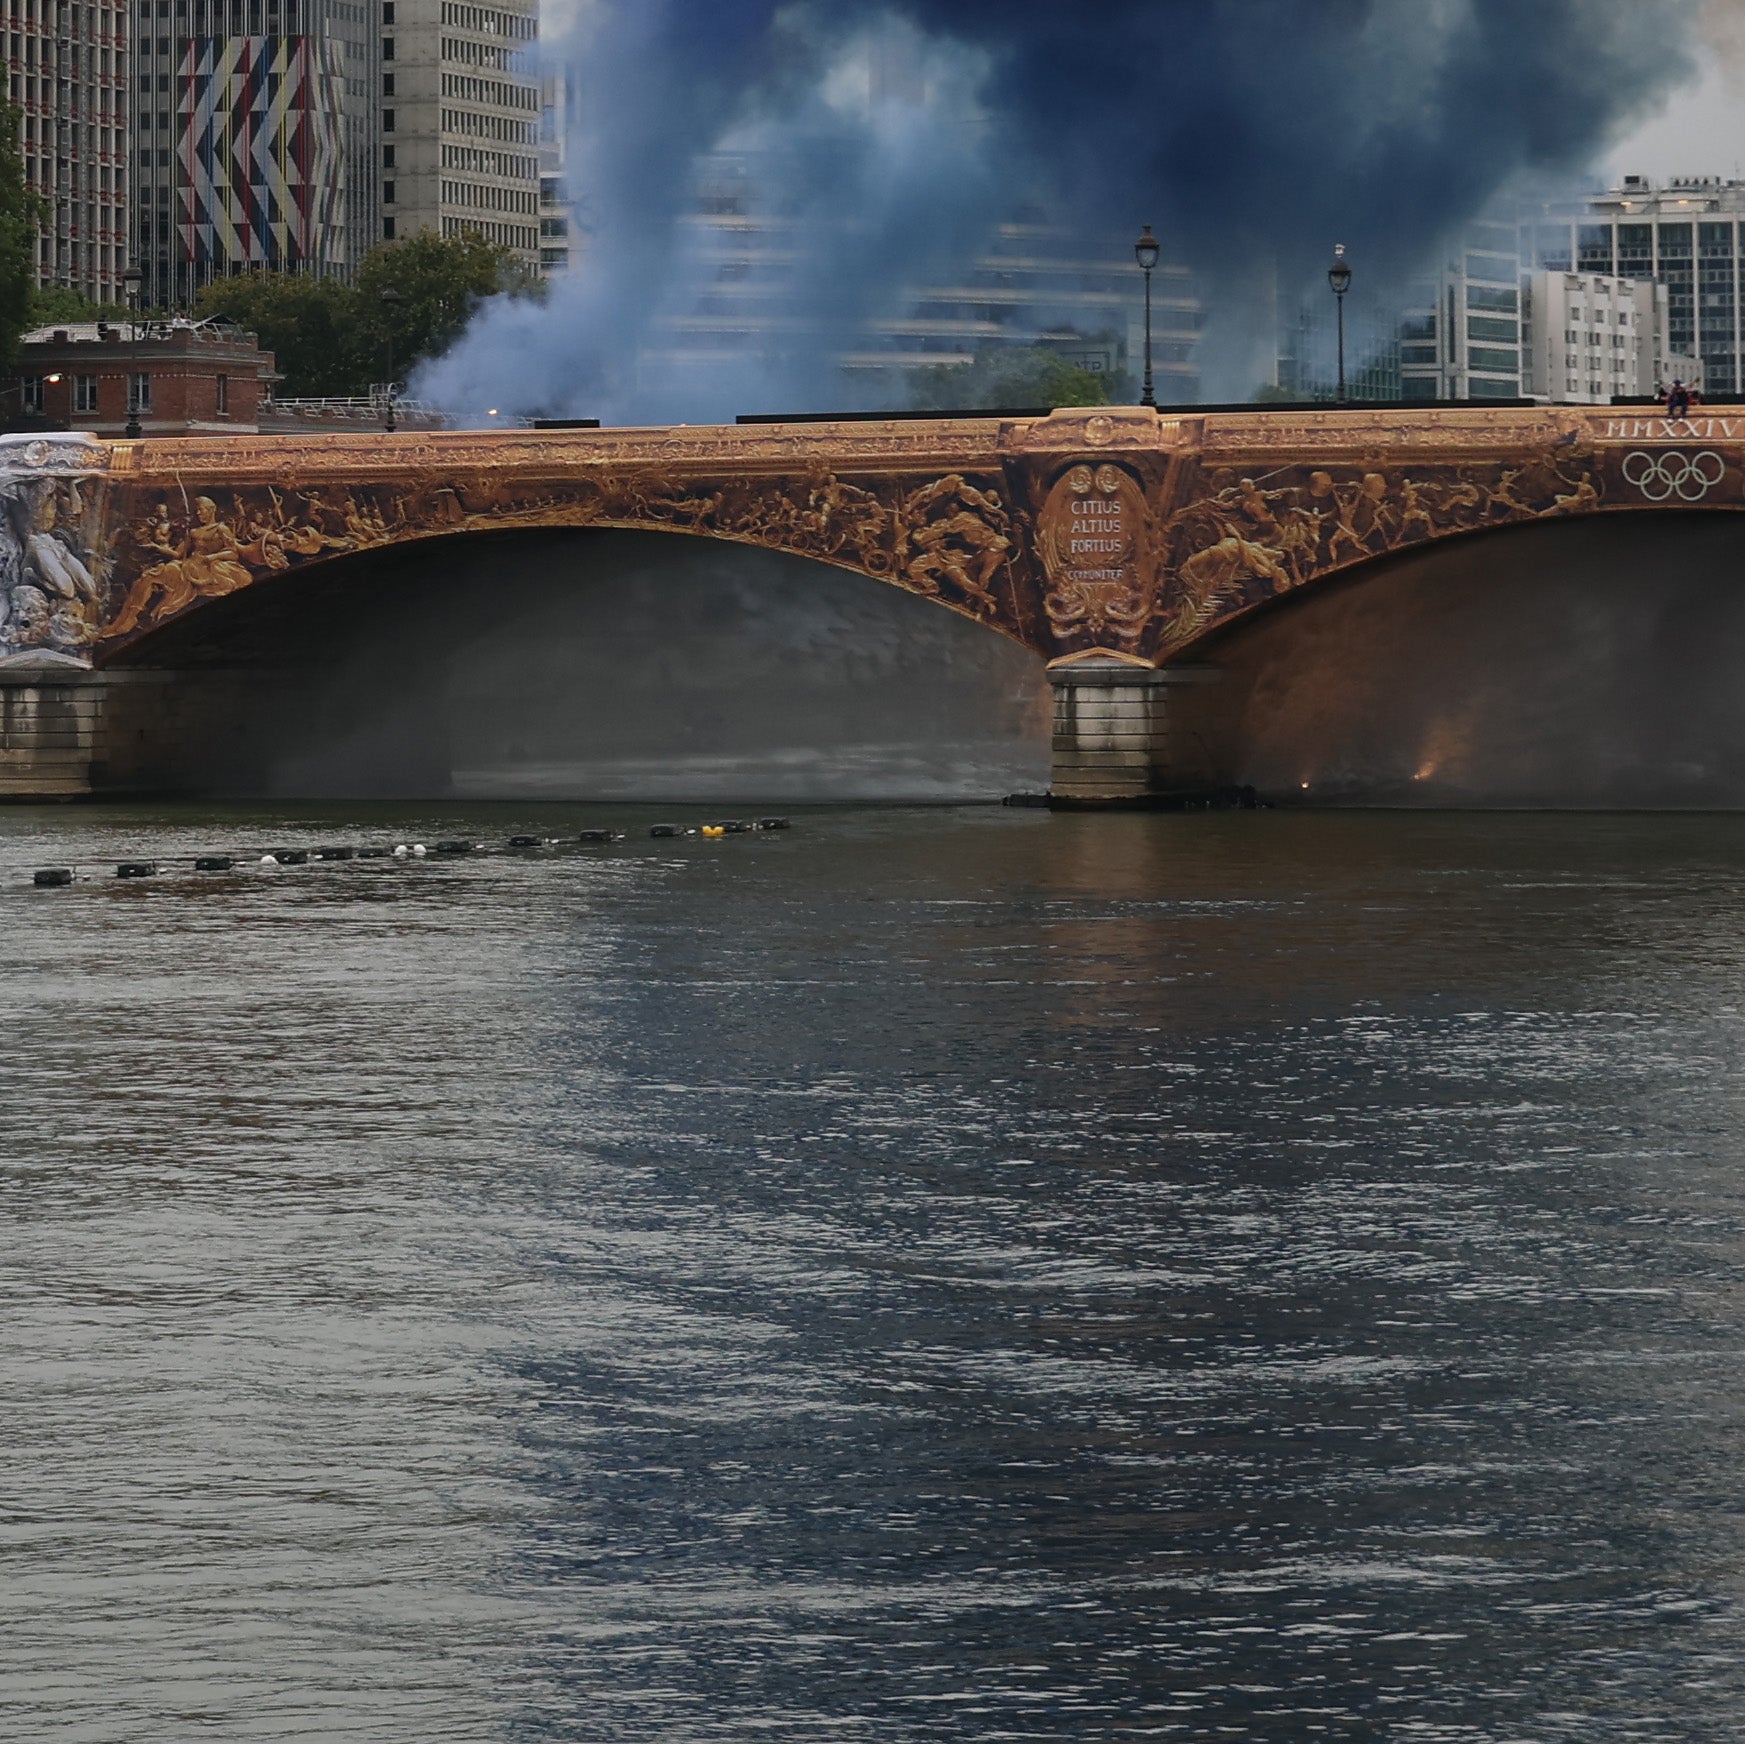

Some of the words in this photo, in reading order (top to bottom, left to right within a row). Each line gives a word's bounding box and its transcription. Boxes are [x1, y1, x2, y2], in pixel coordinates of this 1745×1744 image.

[1606, 419, 1742, 437] MMXXIV
[1071, 500, 1121, 515] CITIUS
[1071, 519, 1121, 534] ALTIUS
[1071, 539, 1122, 554] FORTIUS
